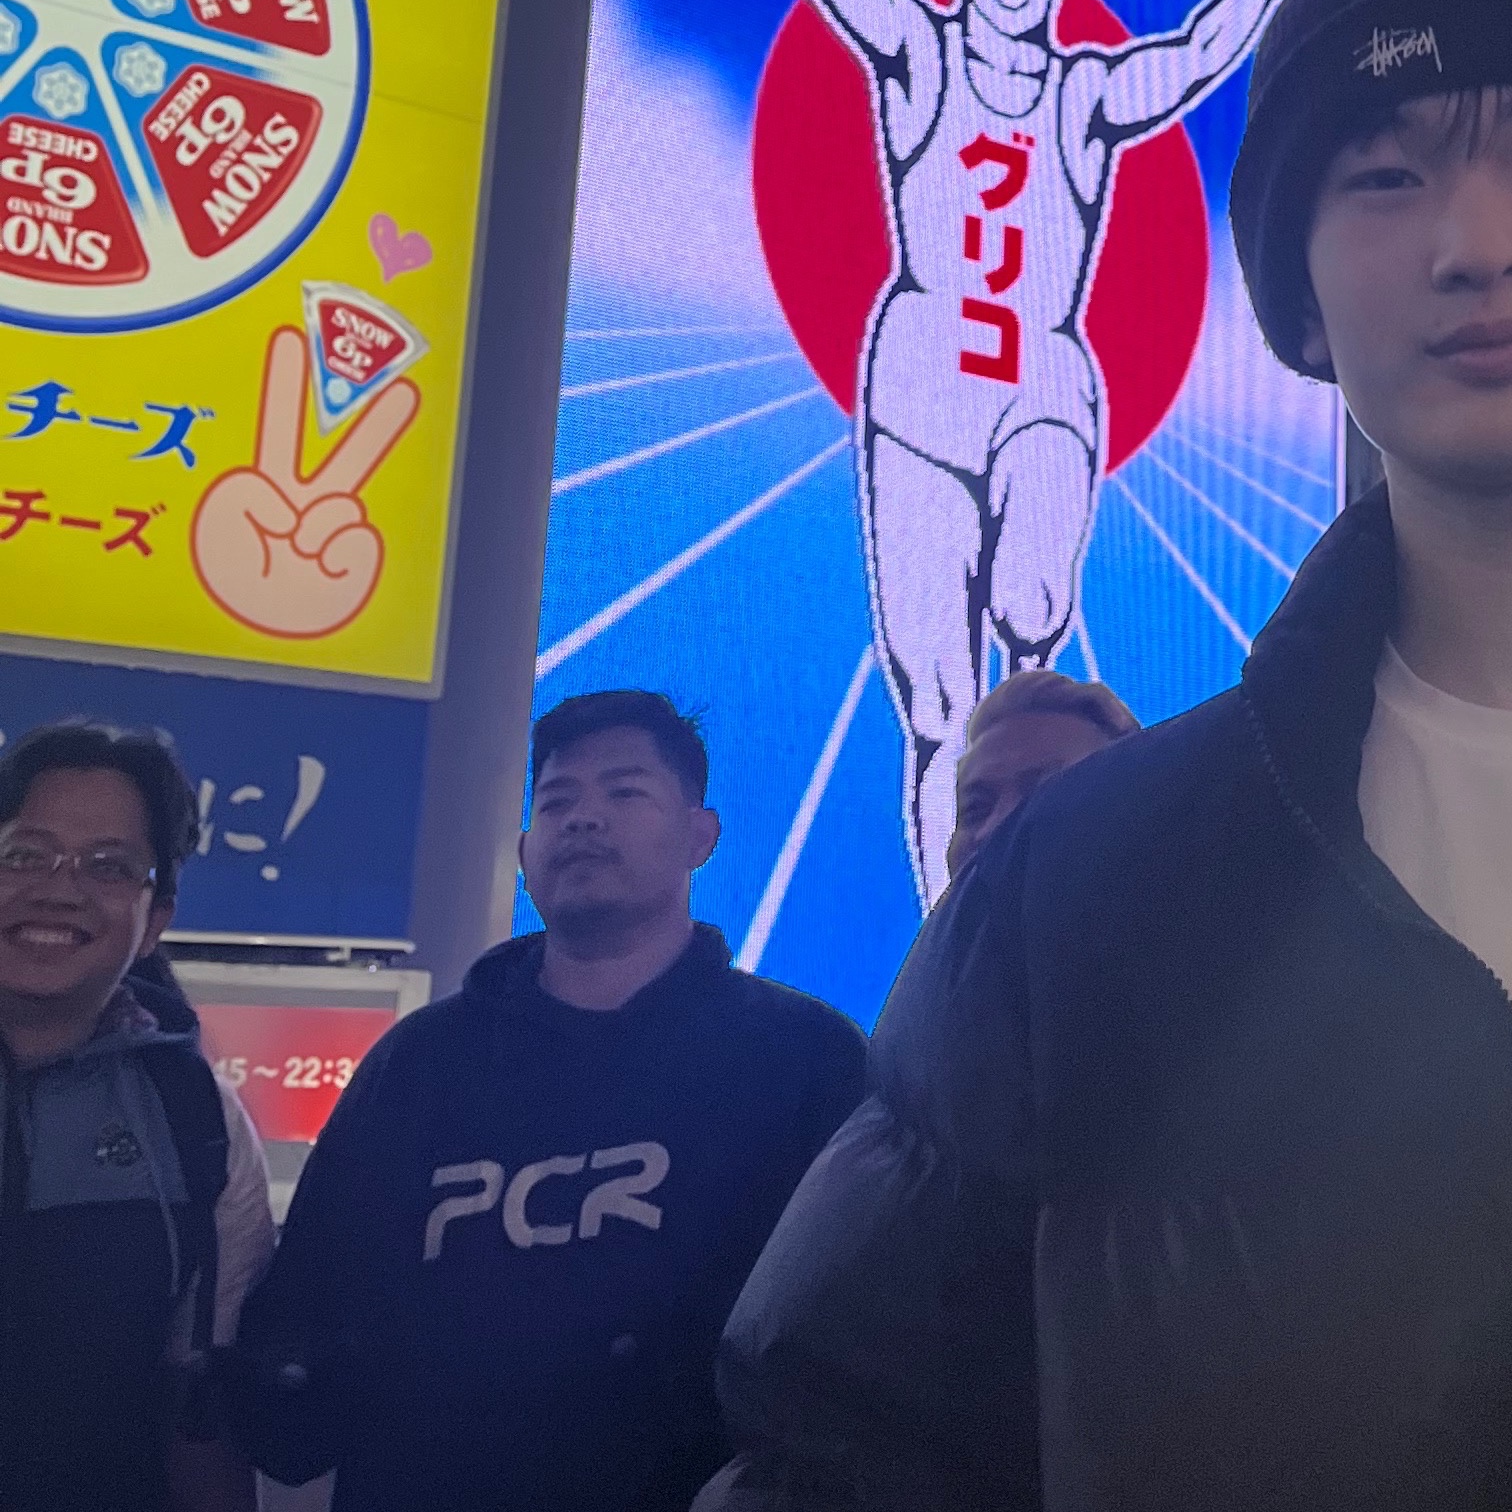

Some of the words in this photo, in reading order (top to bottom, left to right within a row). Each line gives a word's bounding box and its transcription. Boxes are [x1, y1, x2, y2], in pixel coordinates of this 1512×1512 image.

[7, 121, 99, 163] CHEESE
[148, 71, 211, 143] CHEESE
[174, 95, 247, 167] 6P
[0, 149, 97, 210] 6P
[202, 112, 299, 237] SNOW
[0, 214, 112, 271] SNO
[959, 131, 1036, 385] グリコ
[331, 307, 395, 349] SNOW
[332, 335, 373, 368] 6P
[0, 378, 216, 470] チーズ
[0, 487, 167, 559] チーズ
[424, 1140, 671, 1261] PCR
